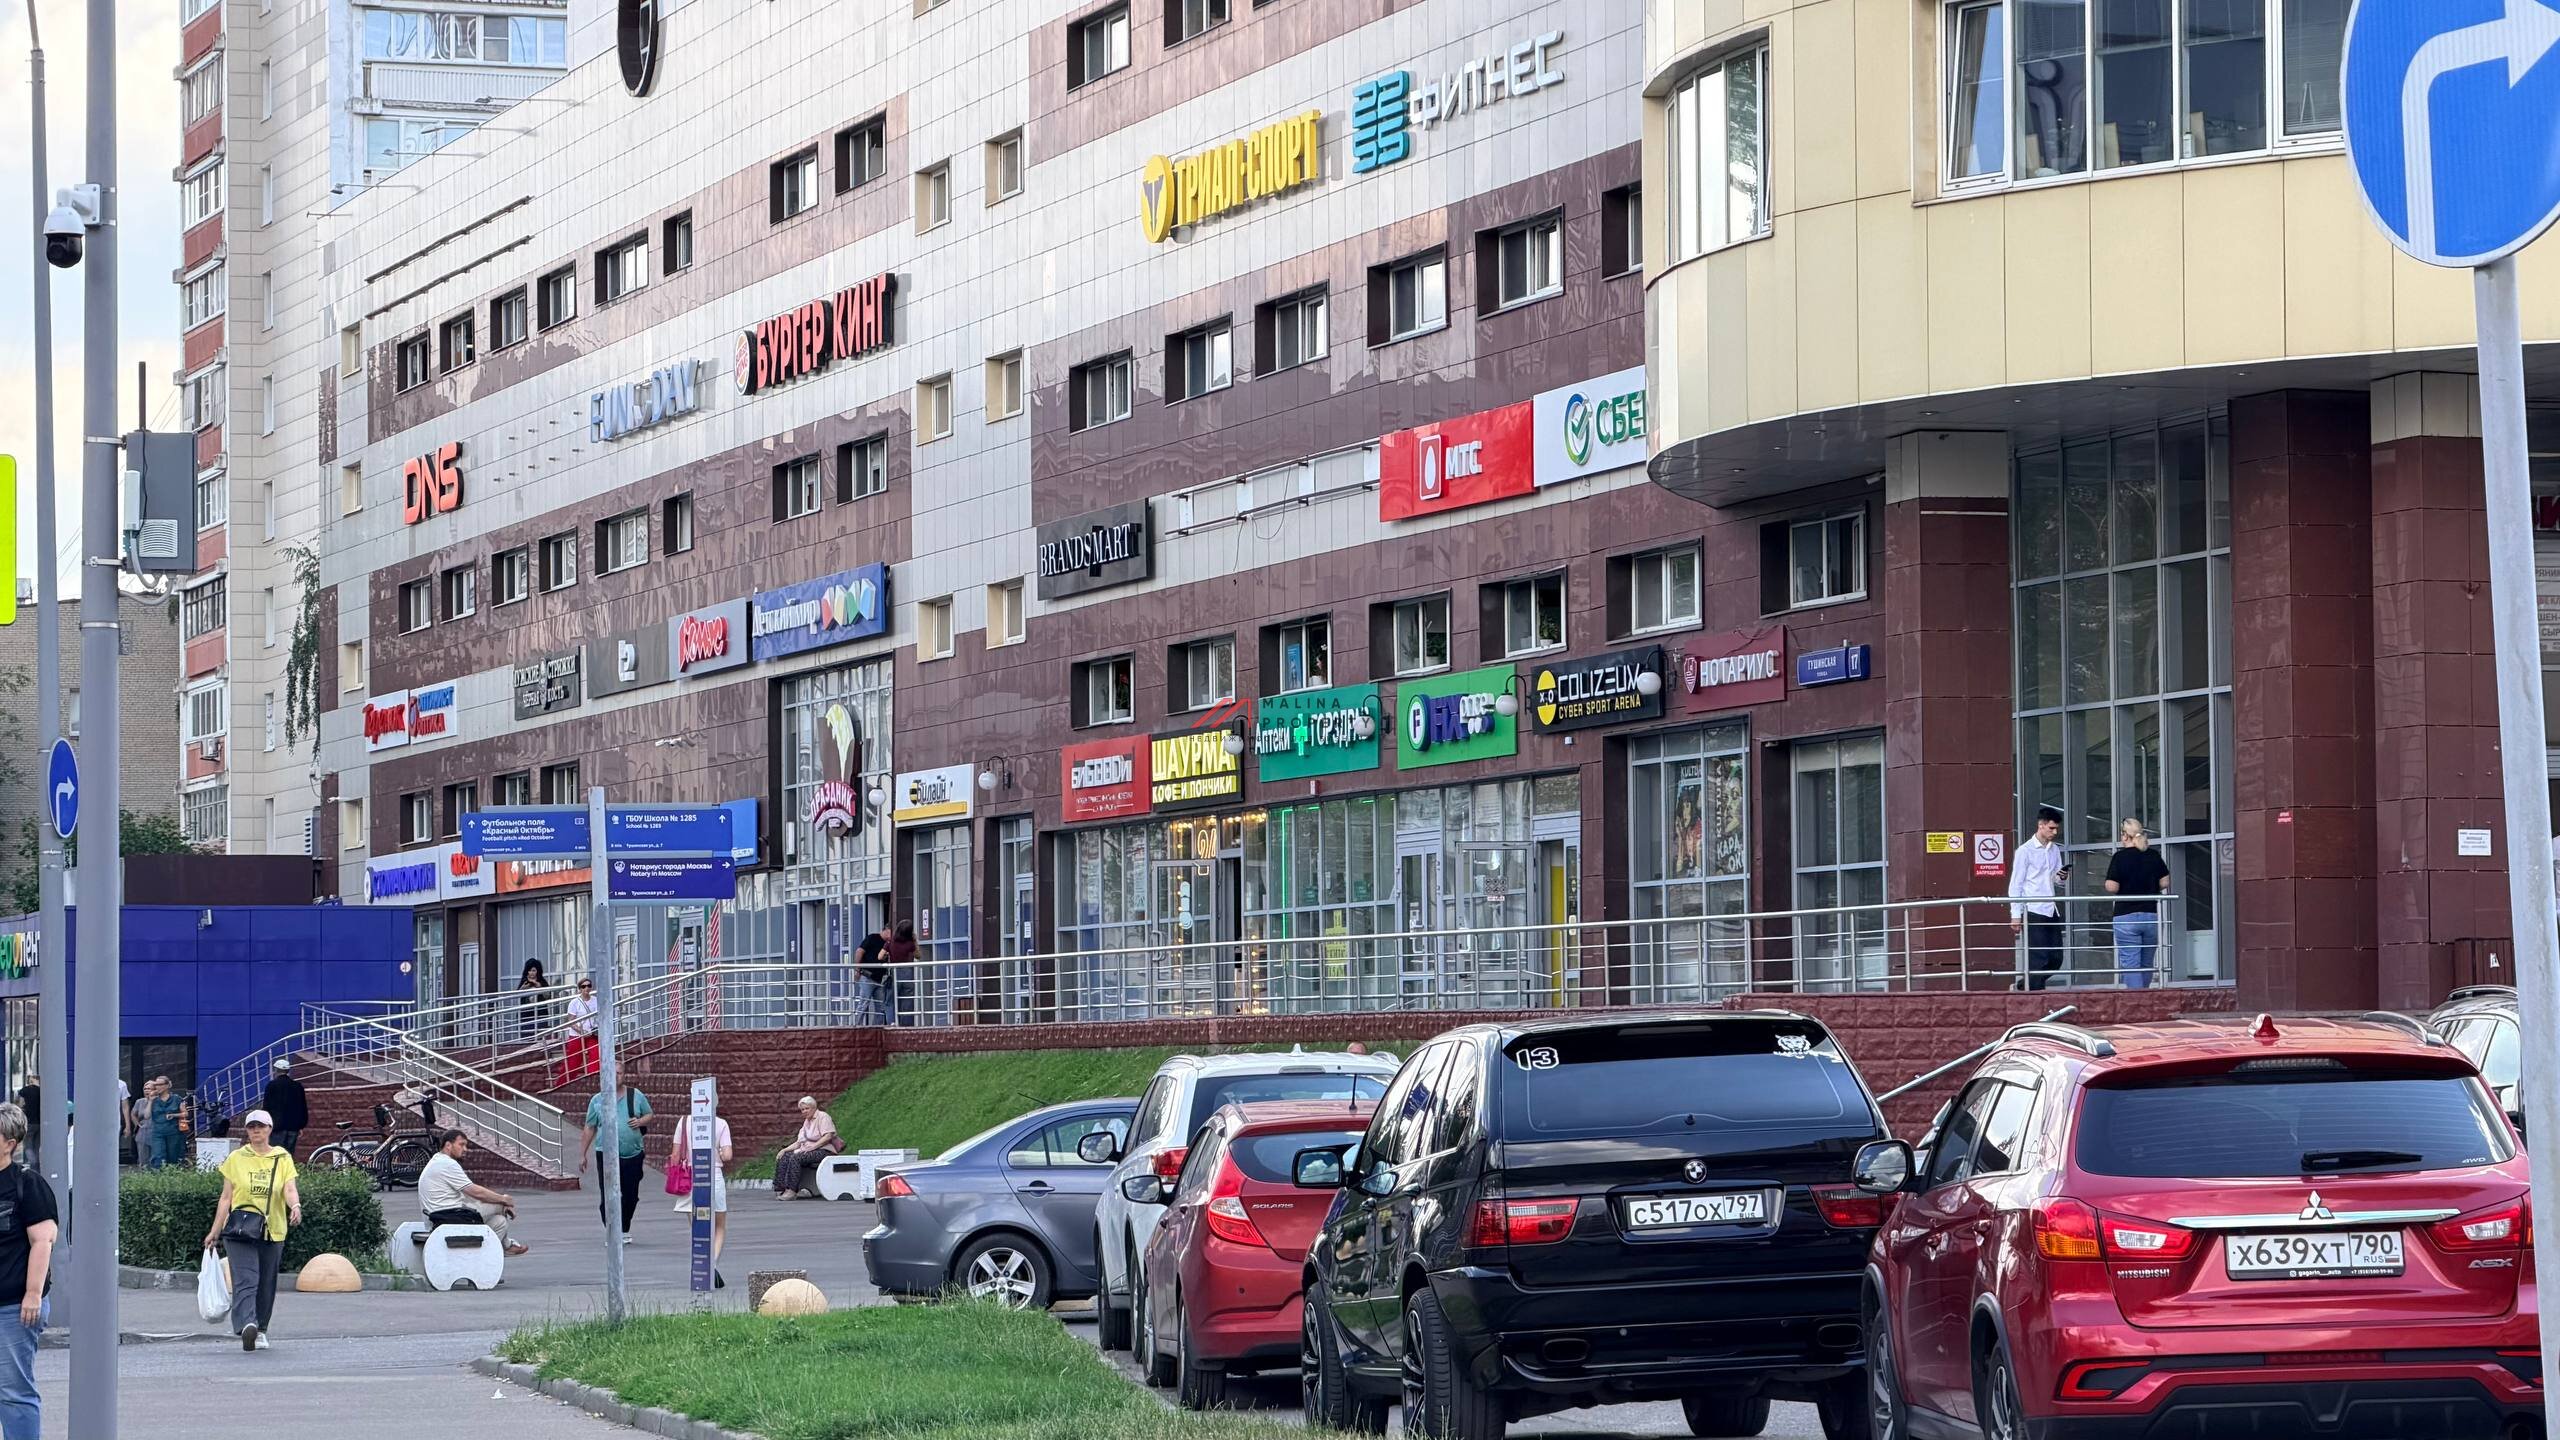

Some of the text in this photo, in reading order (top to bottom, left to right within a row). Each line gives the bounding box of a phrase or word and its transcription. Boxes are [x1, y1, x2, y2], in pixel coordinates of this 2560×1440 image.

[1410, 30, 1564, 131] ФИТНЕС
[757, 300, 827, 389] БУРГЕР
[833, 272, 890, 361] КИНГ
[591, 382, 636, 443] FUN
[652, 357, 700, 423] DAY
[1596, 390, 1646, 446] СБЕ
[1446, 440, 1483, 480] МТС
[404, 441, 462, 525] DNS
[1040, 523, 1132, 577] BRANDSMART
[1700, 650, 1779, 687] НОТАРИУС
[1807, 654, 1858, 671] ТУШИНСКАЯ 17
[1558, 694, 1641, 720] CYBER SPORT ARENA
[1255, 723, 1290, 755] Аптеки
[1152, 729, 1236, 782] ШАУРМА
[1152, 784, 1177, 804] КОФЕ
[1180, 783, 1187, 801] И
[1190, 775, 1235, 799] ПОНЧИКИ
[481, 818, 546, 828] Футбольное поле
[482, 826, 555, 836] «Красный Октябрь»
[625, 815, 643, 823] ГБОУ
[680, 814, 697, 822] 1285
[1728, 851, 1744, 872] ОК
[372, 862, 436, 898] СТОМАТОЛОГИЯ
[1516, 1047, 1559, 1070] 13
[1725, 1195, 1759, 1213] 797
[2237, 1234, 2393, 1266] Х639ХТ 790
[2364, 1255, 2385, 1263] RUS
[2468, 1258, 2513, 1269] ASX
[2117, 1268, 2170, 1279] MITSUBISHI
